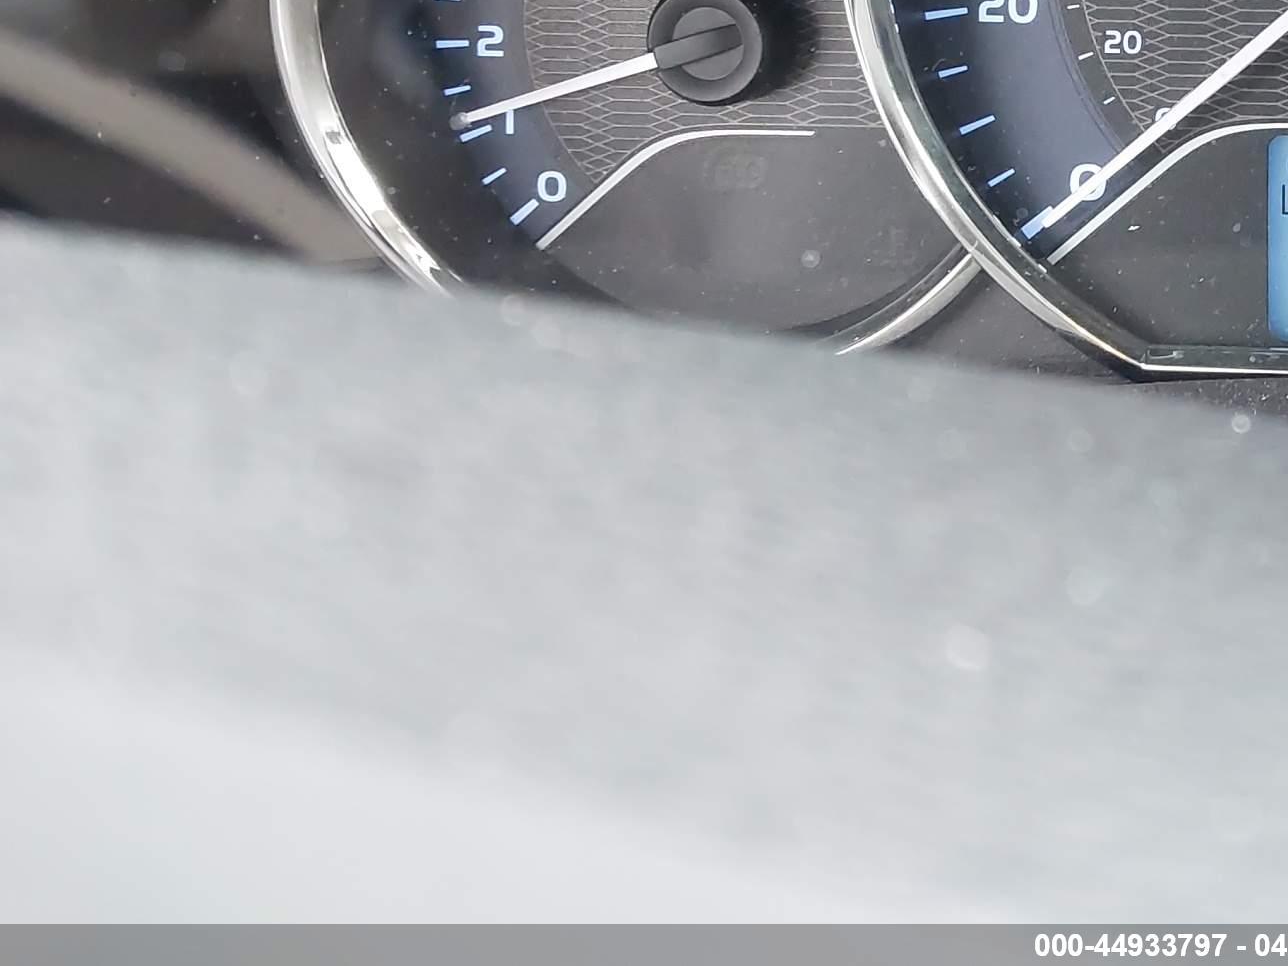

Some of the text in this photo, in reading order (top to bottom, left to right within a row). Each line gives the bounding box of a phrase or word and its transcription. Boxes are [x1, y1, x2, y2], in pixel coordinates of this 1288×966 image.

[476, 26, 505, 57] 2
[1103, 30, 1142, 55] 20
[537, 171, 567, 202] 0
